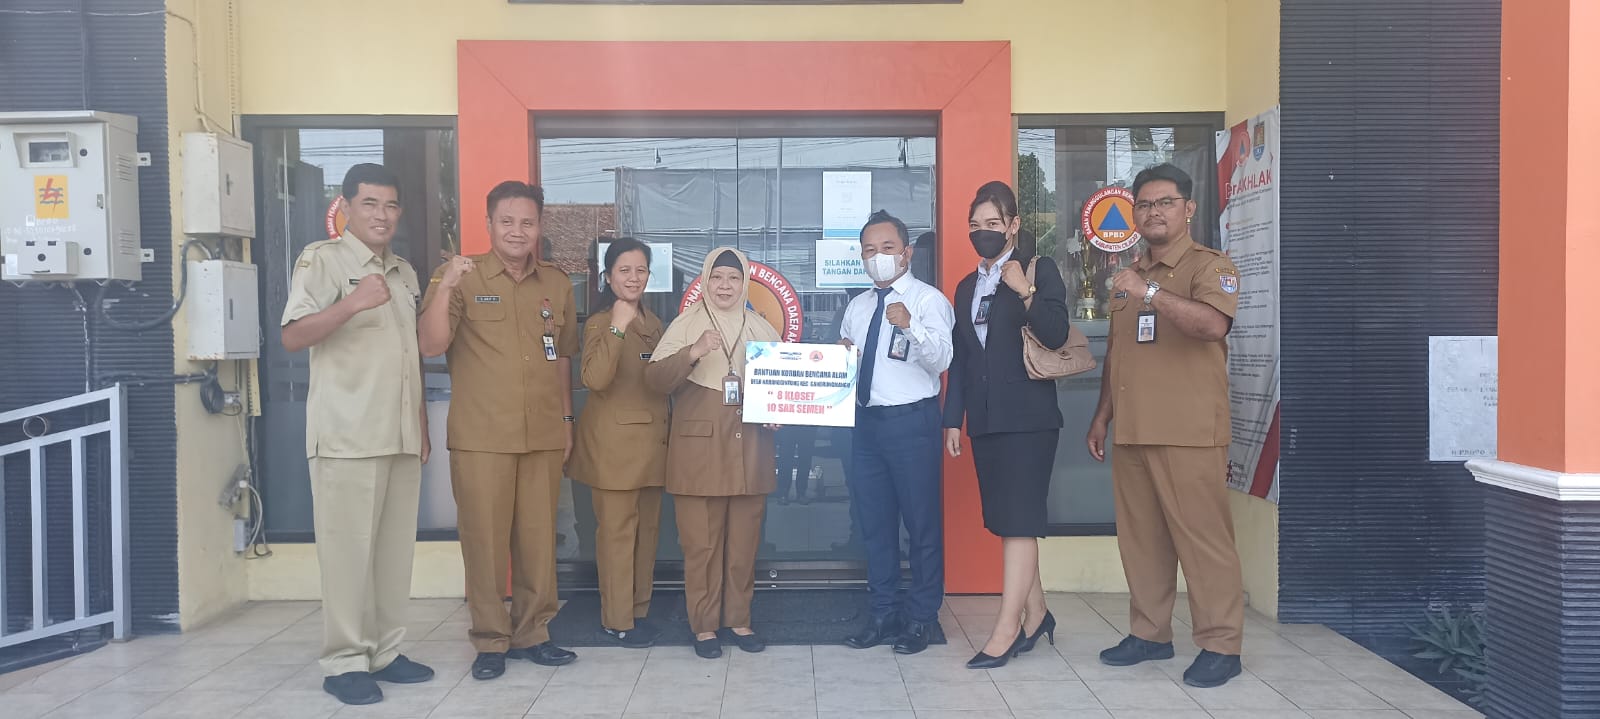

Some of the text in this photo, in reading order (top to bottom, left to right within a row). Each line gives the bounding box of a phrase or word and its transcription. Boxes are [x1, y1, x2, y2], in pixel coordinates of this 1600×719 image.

[1095, 239, 1122, 251] KABUPATEN
[758, 268, 793, 306] BENCANA
[754, 368, 780, 376] BANTUAN
[805, 370, 831, 378] BENCANA
[831, 371, 848, 379] ALAM
[777, 390, 783, 400] 8
[784, 390, 816, 401] KLOSET
[767, 403, 777, 412] 10
[778, 403, 796, 413] SAK
[796, 404, 825, 414] SEMEN
